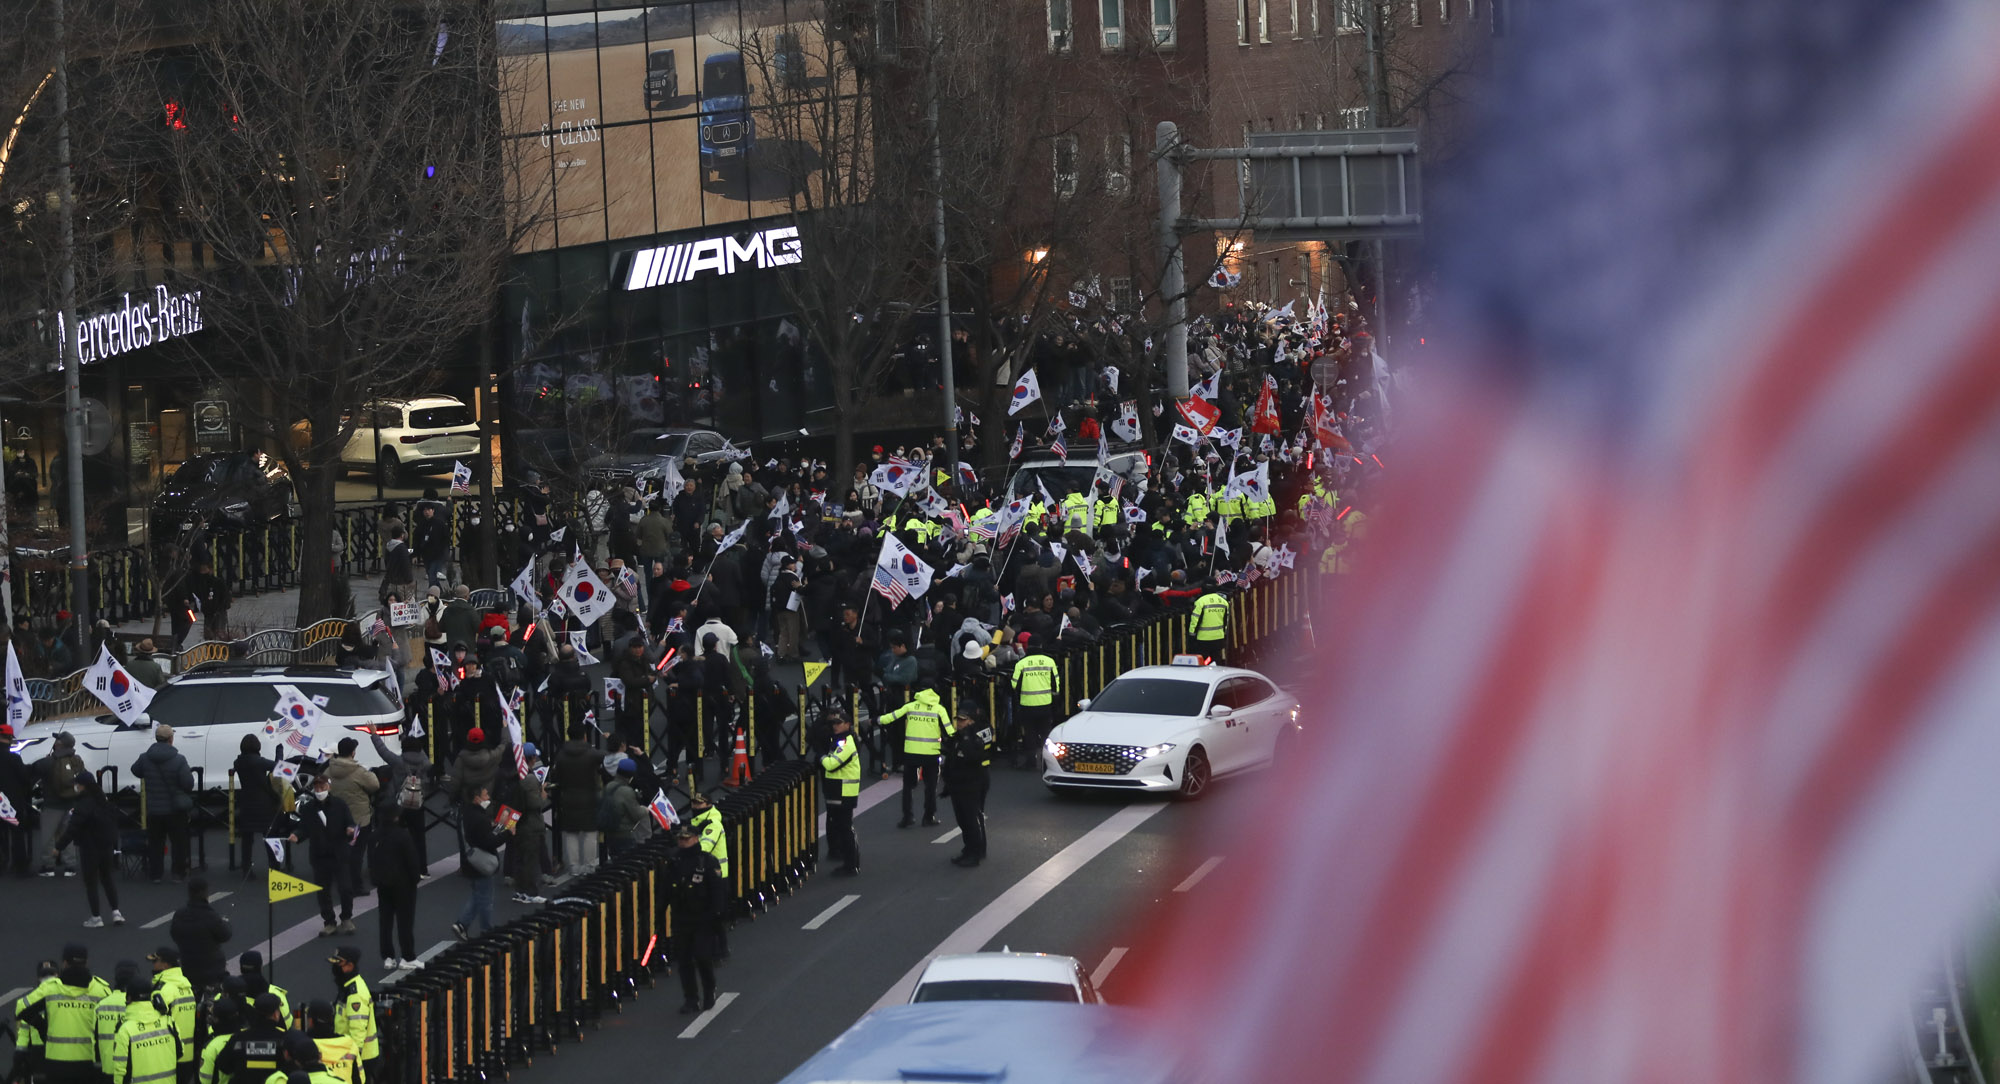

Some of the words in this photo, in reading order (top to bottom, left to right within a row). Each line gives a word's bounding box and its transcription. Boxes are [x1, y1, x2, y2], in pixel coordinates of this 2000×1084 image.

[553, 100, 568, 113] THE
[570, 98, 585, 110] NEW
[271, 881, 304, 892] 26기-3
[136, 1036, 171, 1049] POLICE
